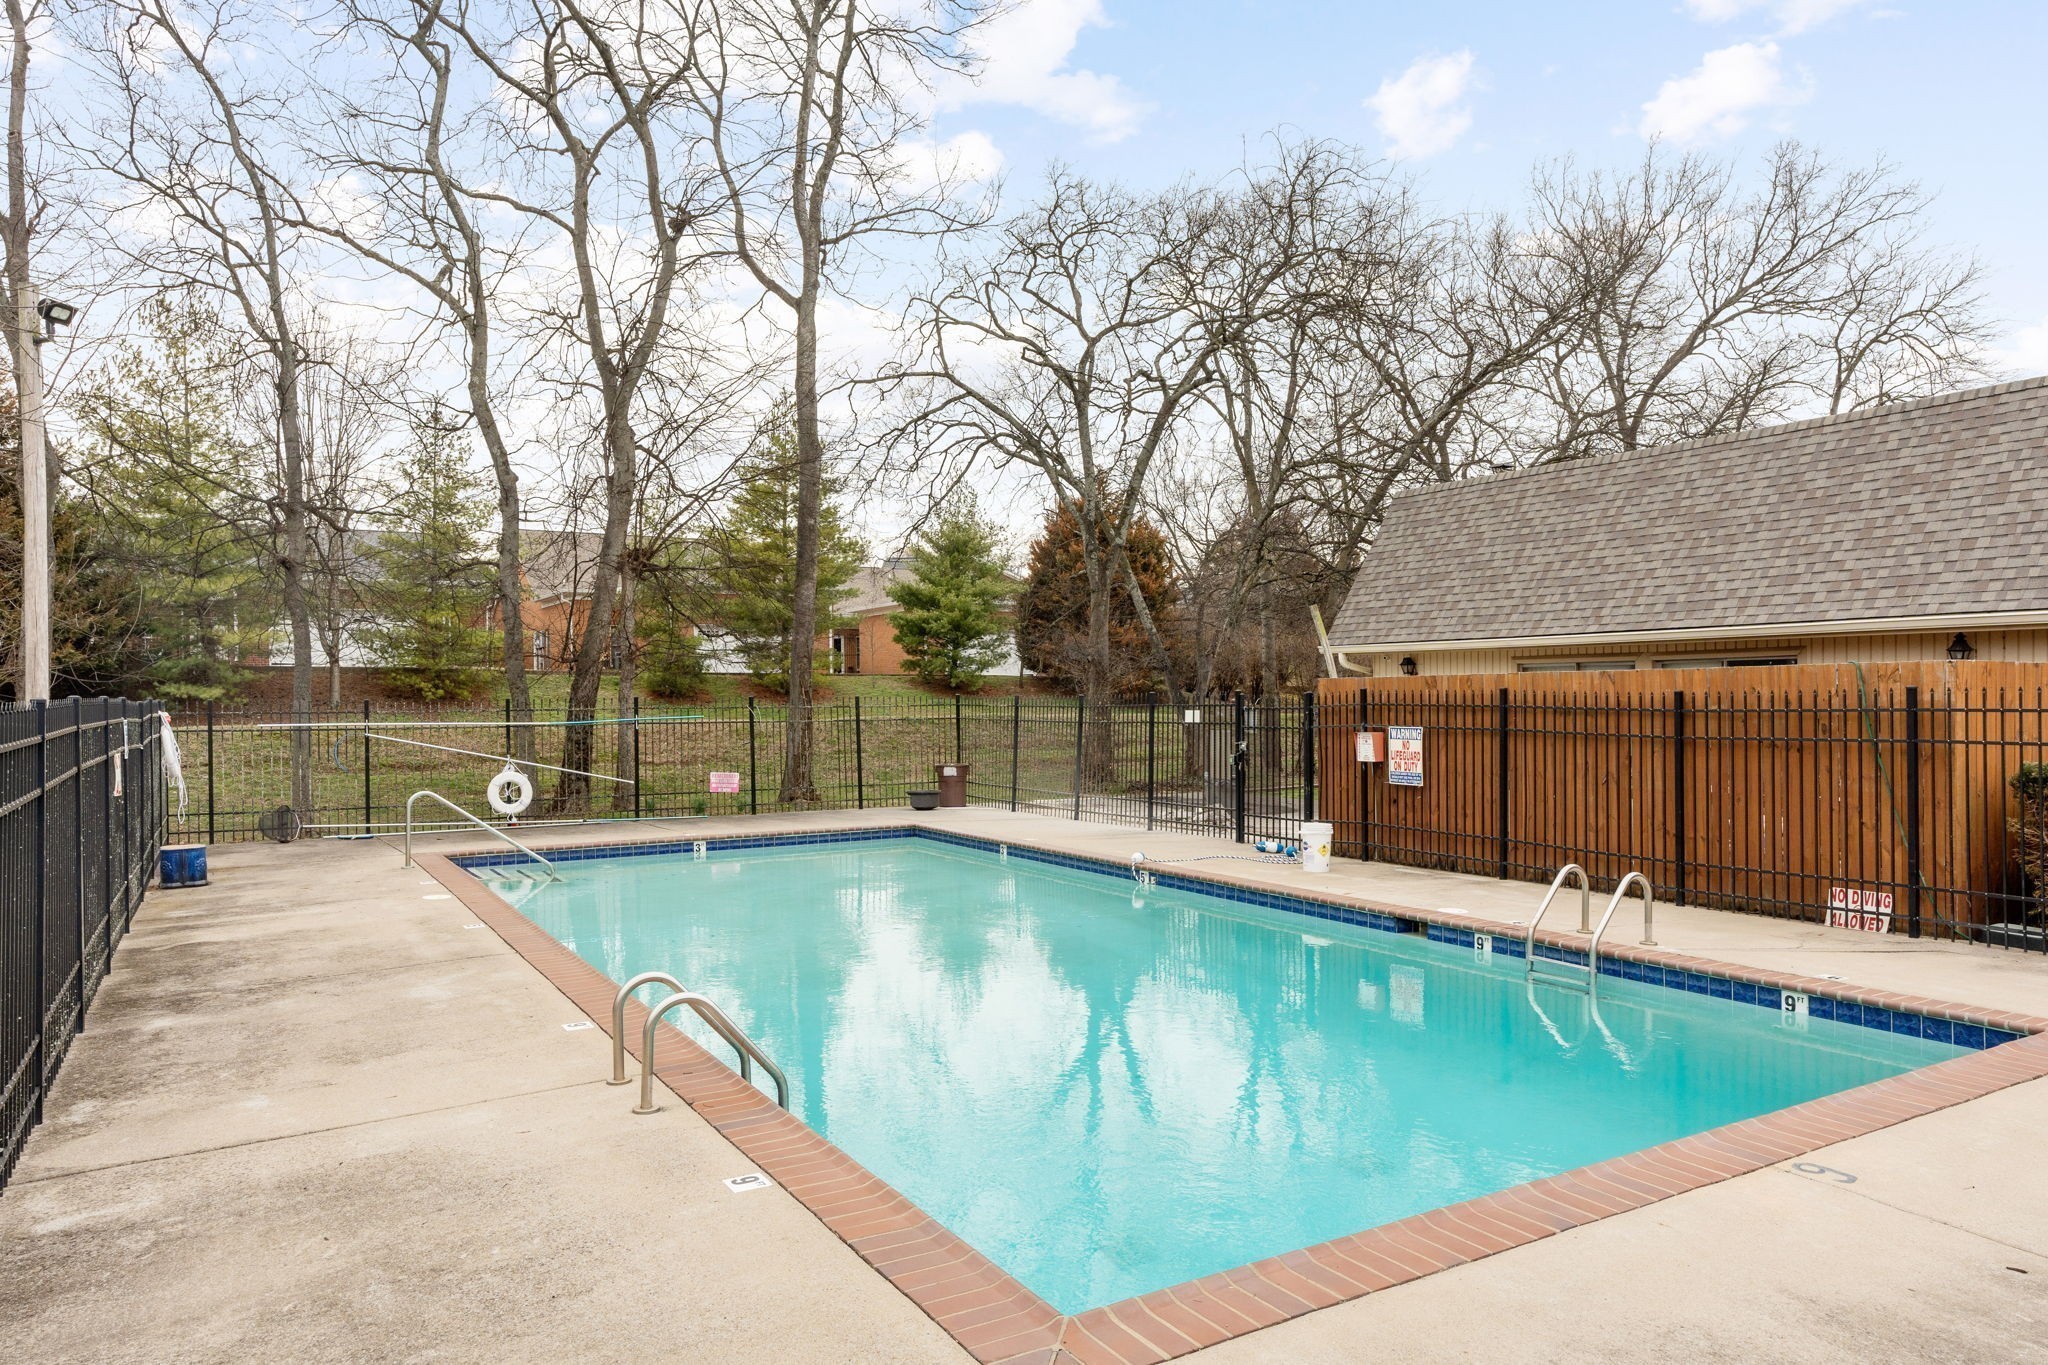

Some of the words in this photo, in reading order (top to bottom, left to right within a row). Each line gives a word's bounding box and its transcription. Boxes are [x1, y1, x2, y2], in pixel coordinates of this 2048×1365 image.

[1390, 728, 1421, 740] WARNING
[1402, 740, 1410, 750] NO
[1391, 750, 1421, 761] LIFEGUARD
[1393, 761, 1402, 771] ON
[1404, 761, 1418, 771] DUTY
[695, 843, 701, 852] 3
[1831, 888, 1847, 903] NO
[1476, 936, 1484, 950] 9
[1784, 995, 1796, 1012] 9
